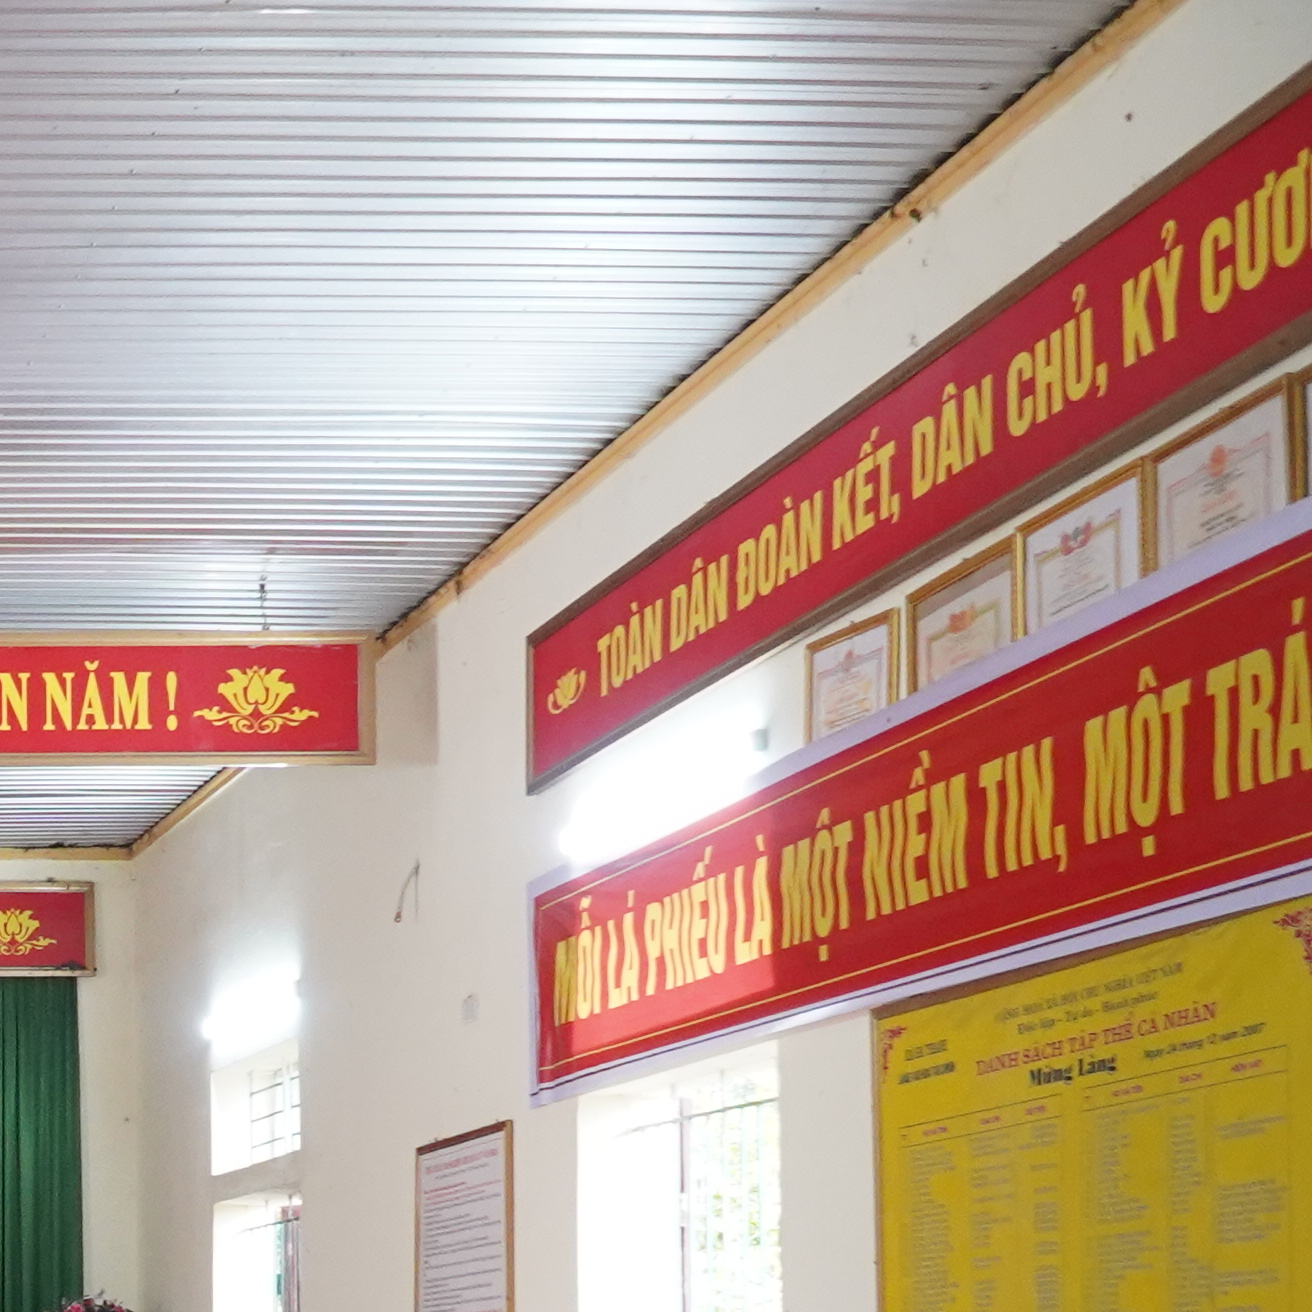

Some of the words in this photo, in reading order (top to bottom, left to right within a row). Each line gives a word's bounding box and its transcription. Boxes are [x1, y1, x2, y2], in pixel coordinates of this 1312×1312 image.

[597, 598, 663, 698] TOÀN
[670, 554, 730, 653] DÂN
[736, 489, 824, 612] ĐOÀN
[831, 426, 901, 551] KẾT,
[912, 374, 994, 500] DÂN
[1007, 283, 1109, 437] CHỦ,
[1122, 219, 1184, 368] KỶ
[1199, 147, 1312, 315] CƯƠ
[43, 658, 153, 732] NĂM
[166, 671, 179, 732] !
[553, 895, 602, 1027] MỖI
[607, 889, 640, 1010] LÁ
[644, 845, 728, 997] PHIẾU
[734, 833, 773, 966] LÀ
[779, 807, 854, 962] MỘT
[862, 749, 969, 921] NIỀM
[978, 736, 1068, 874] TIN,
[1082, 664, 1192, 858] MỘT
